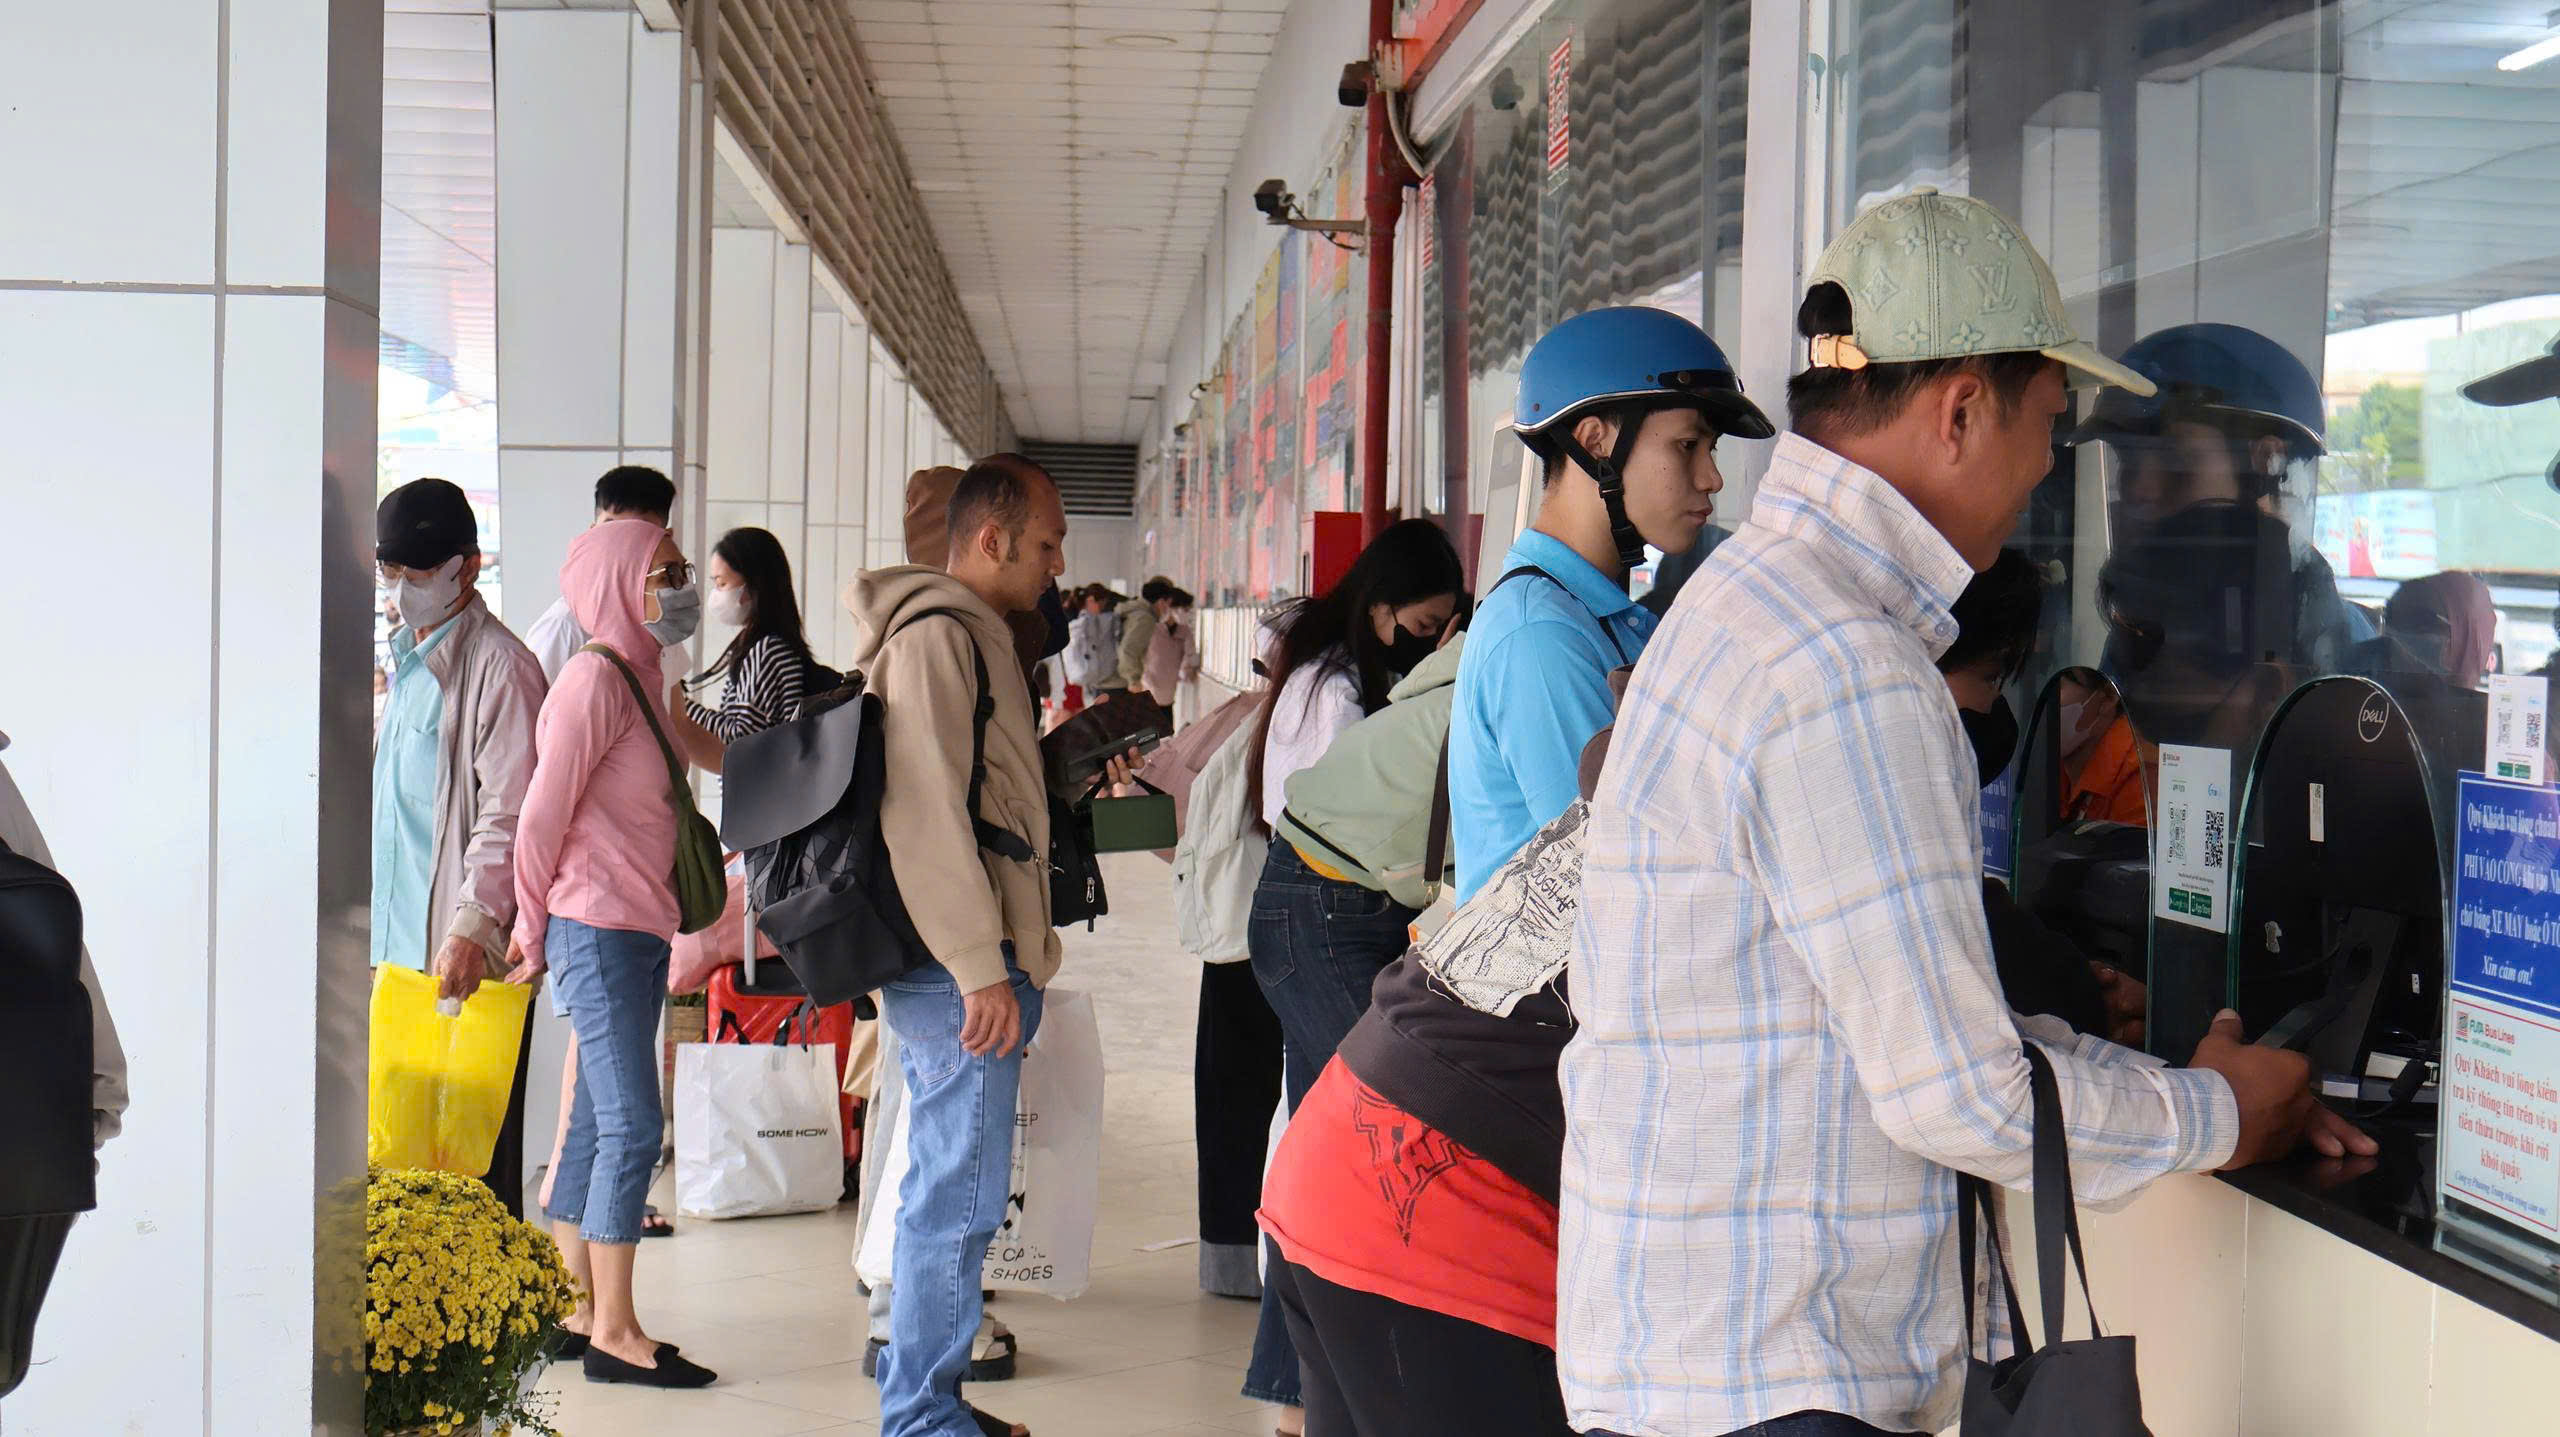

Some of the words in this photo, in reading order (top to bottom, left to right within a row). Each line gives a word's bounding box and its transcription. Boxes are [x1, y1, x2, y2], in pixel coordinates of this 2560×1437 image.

[2362, 709, 2384, 723] DELL
[2467, 802, 2482, 833] Quý
[2483, 805, 2505, 830] Khách
[2464, 848, 2479, 878] PHÍ
[2491, 908, 2503, 934] XE
[2504, 905, 2524, 938] MÁY
[2482, 954, 2498, 977] Xin
[2484, 1024, 2497, 1040] Bus
[2497, 1028, 2515, 1045] Lines
[2455, 1053, 2471, 1078] Quý
[2474, 1058, 2500, 1084] Khách
[2502, 1071, 2514, 1089] vui
[2453, 1084, 2464, 1100] tra
[2479, 1090, 2501, 1118] thông
[2503, 1099, 2514, 1118] tin
[757, 1129, 793, 1138] SOME
[795, 1128, 829, 1137] HOW
[2520, 1134, 2534, 1156] khi
[991, 1264, 1053, 1282] SHOES
